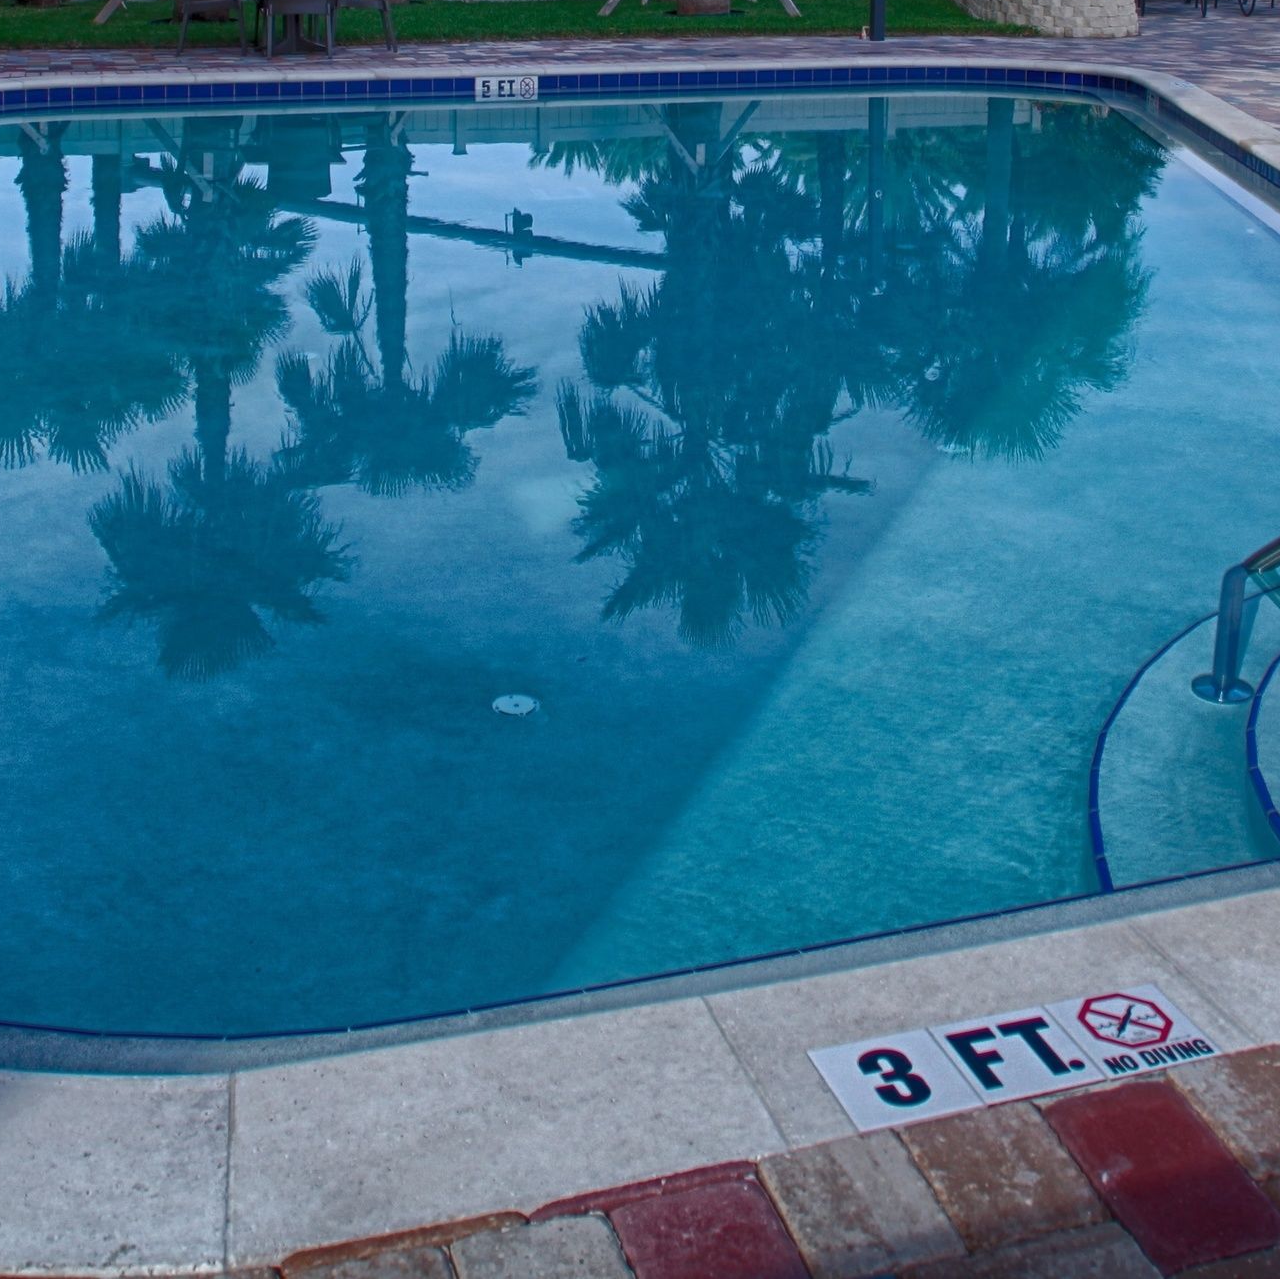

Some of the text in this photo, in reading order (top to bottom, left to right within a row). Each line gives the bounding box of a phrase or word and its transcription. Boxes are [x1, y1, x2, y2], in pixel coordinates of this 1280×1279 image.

[857, 1016, 1087, 1108] 3 FT.
[1103, 1038, 1215, 1075] NO DIVING
